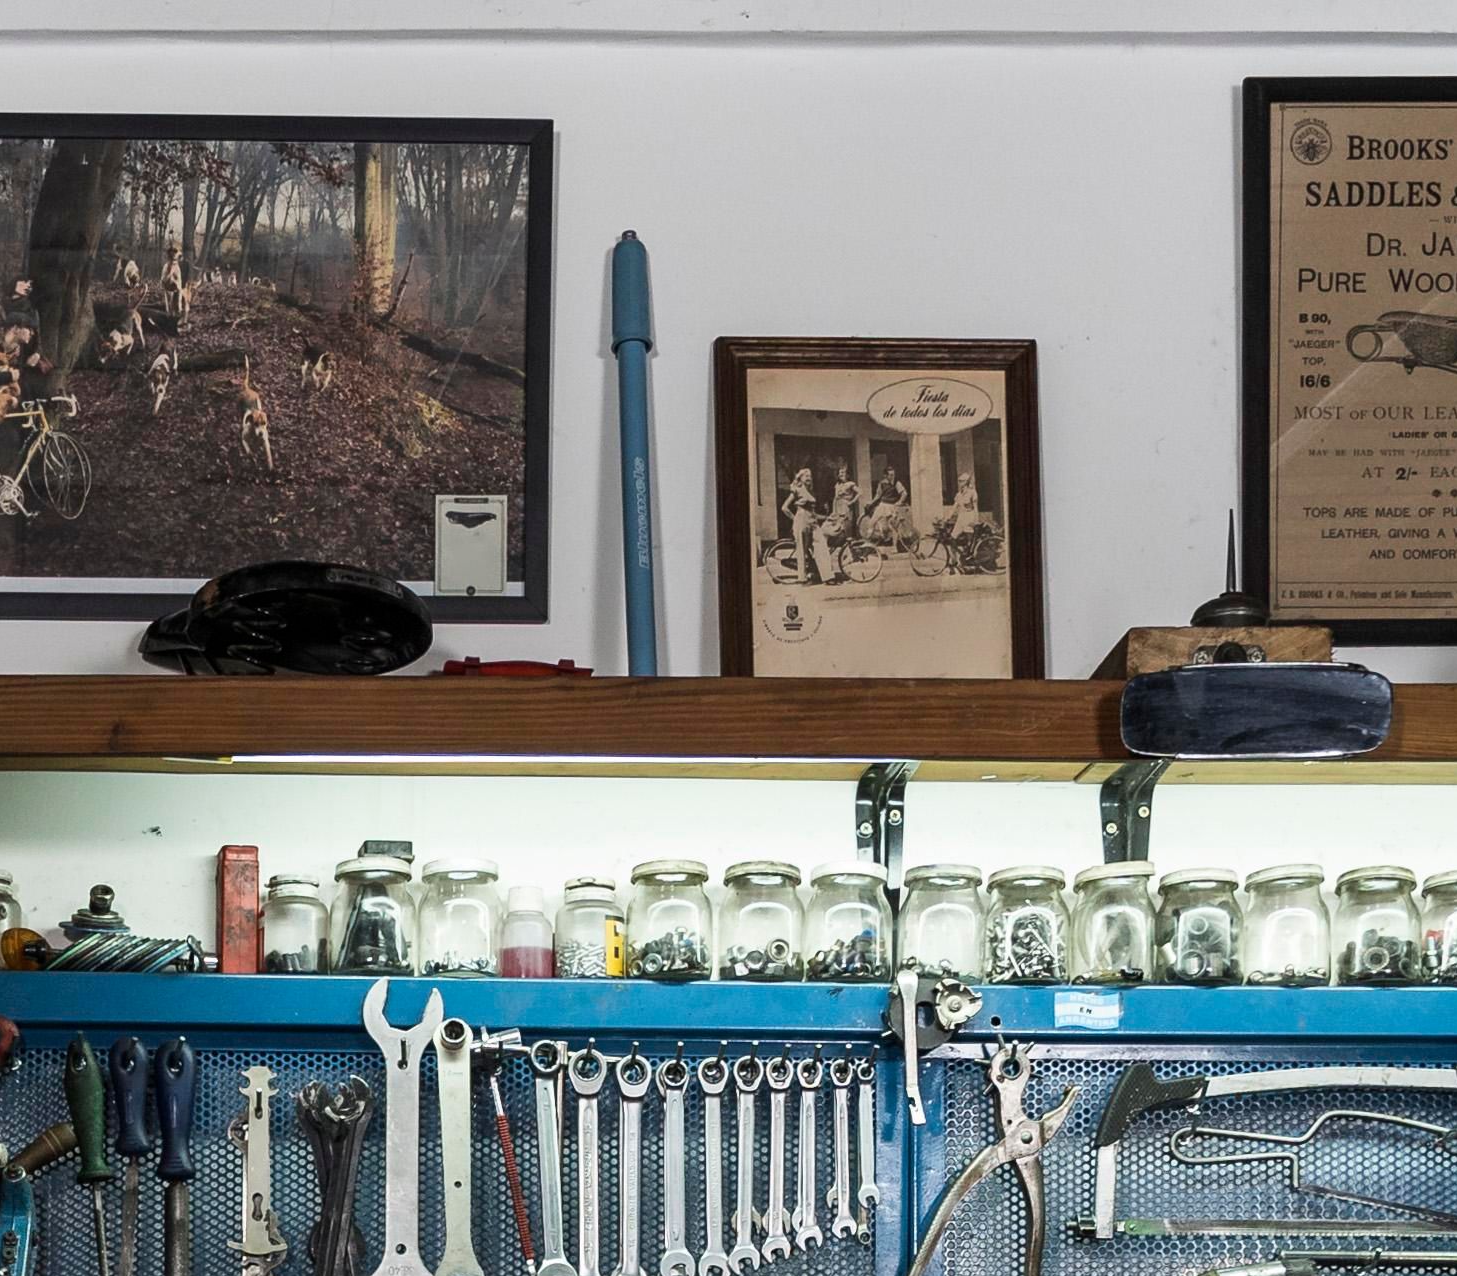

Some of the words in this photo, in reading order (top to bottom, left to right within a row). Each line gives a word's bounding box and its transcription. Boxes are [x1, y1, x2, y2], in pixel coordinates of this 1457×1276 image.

[1305, 181, 1442, 208] SADDLES
[1298, 268, 1367, 293] PURE
[883, 405, 897, 418] de
[901, 406, 929, 418] todos
[932, 404, 947, 417] los
[1293, 405, 1344, 420] MOST
[1372, 405, 1415, 420] OUR
[1361, 466, 1384, 479] AT
[1303, 506, 1336, 518] TOPS
[1343, 506, 1367, 518] ARE
[1375, 506, 1412, 518] MADE
[1418, 506, 1436, 518] OF
[1387, 528, 1430, 539] GIVING
[1436, 528, 1446, 539] A
[1369, 548, 1396, 560] AND
